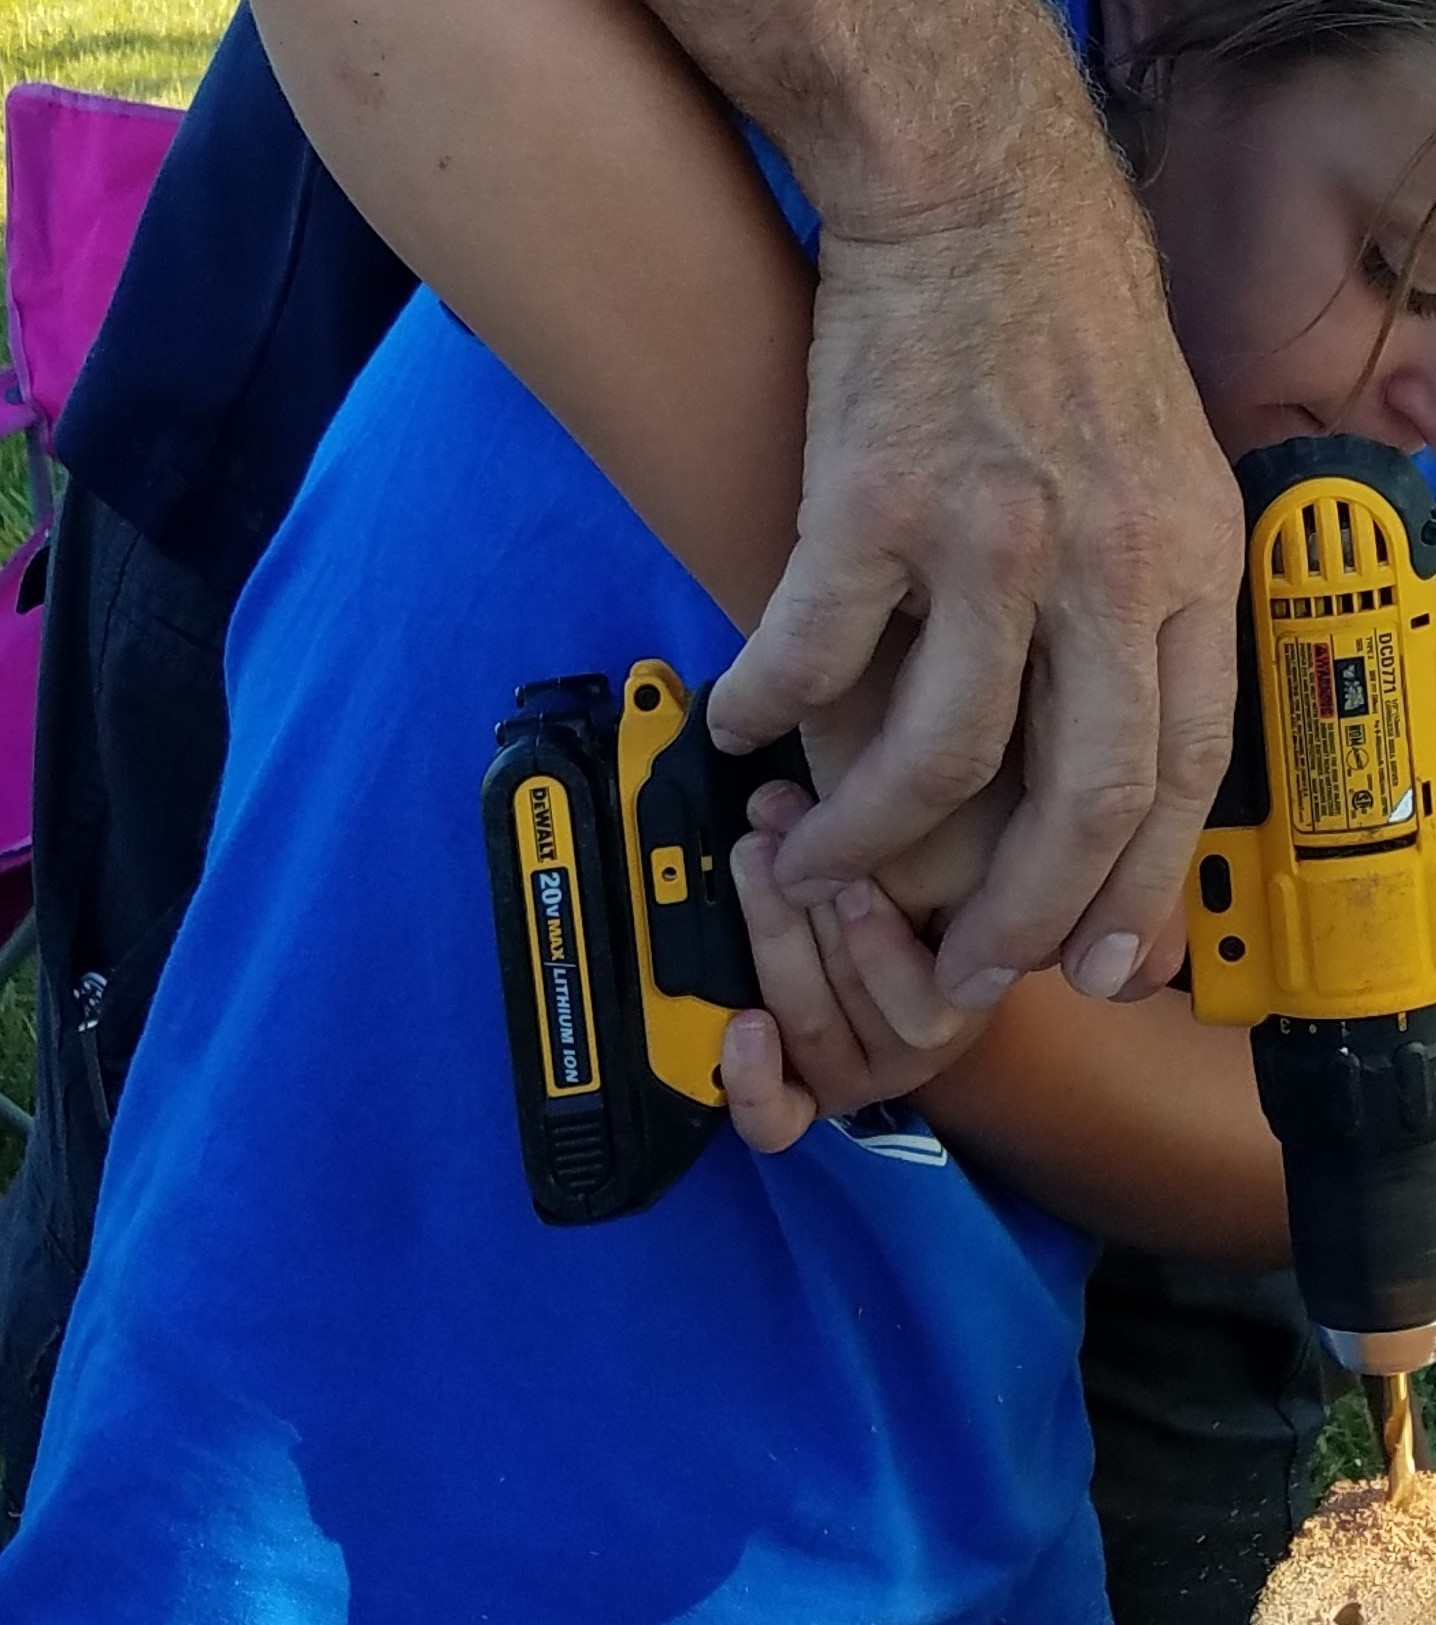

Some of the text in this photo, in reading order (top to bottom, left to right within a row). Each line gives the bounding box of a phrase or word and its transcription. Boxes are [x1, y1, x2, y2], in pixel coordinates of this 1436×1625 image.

[1378, 632, 1397, 694] DCD771
[529, 786, 557, 863] DEWALT
[553, 968, 579, 1083] LITHIUM ION
